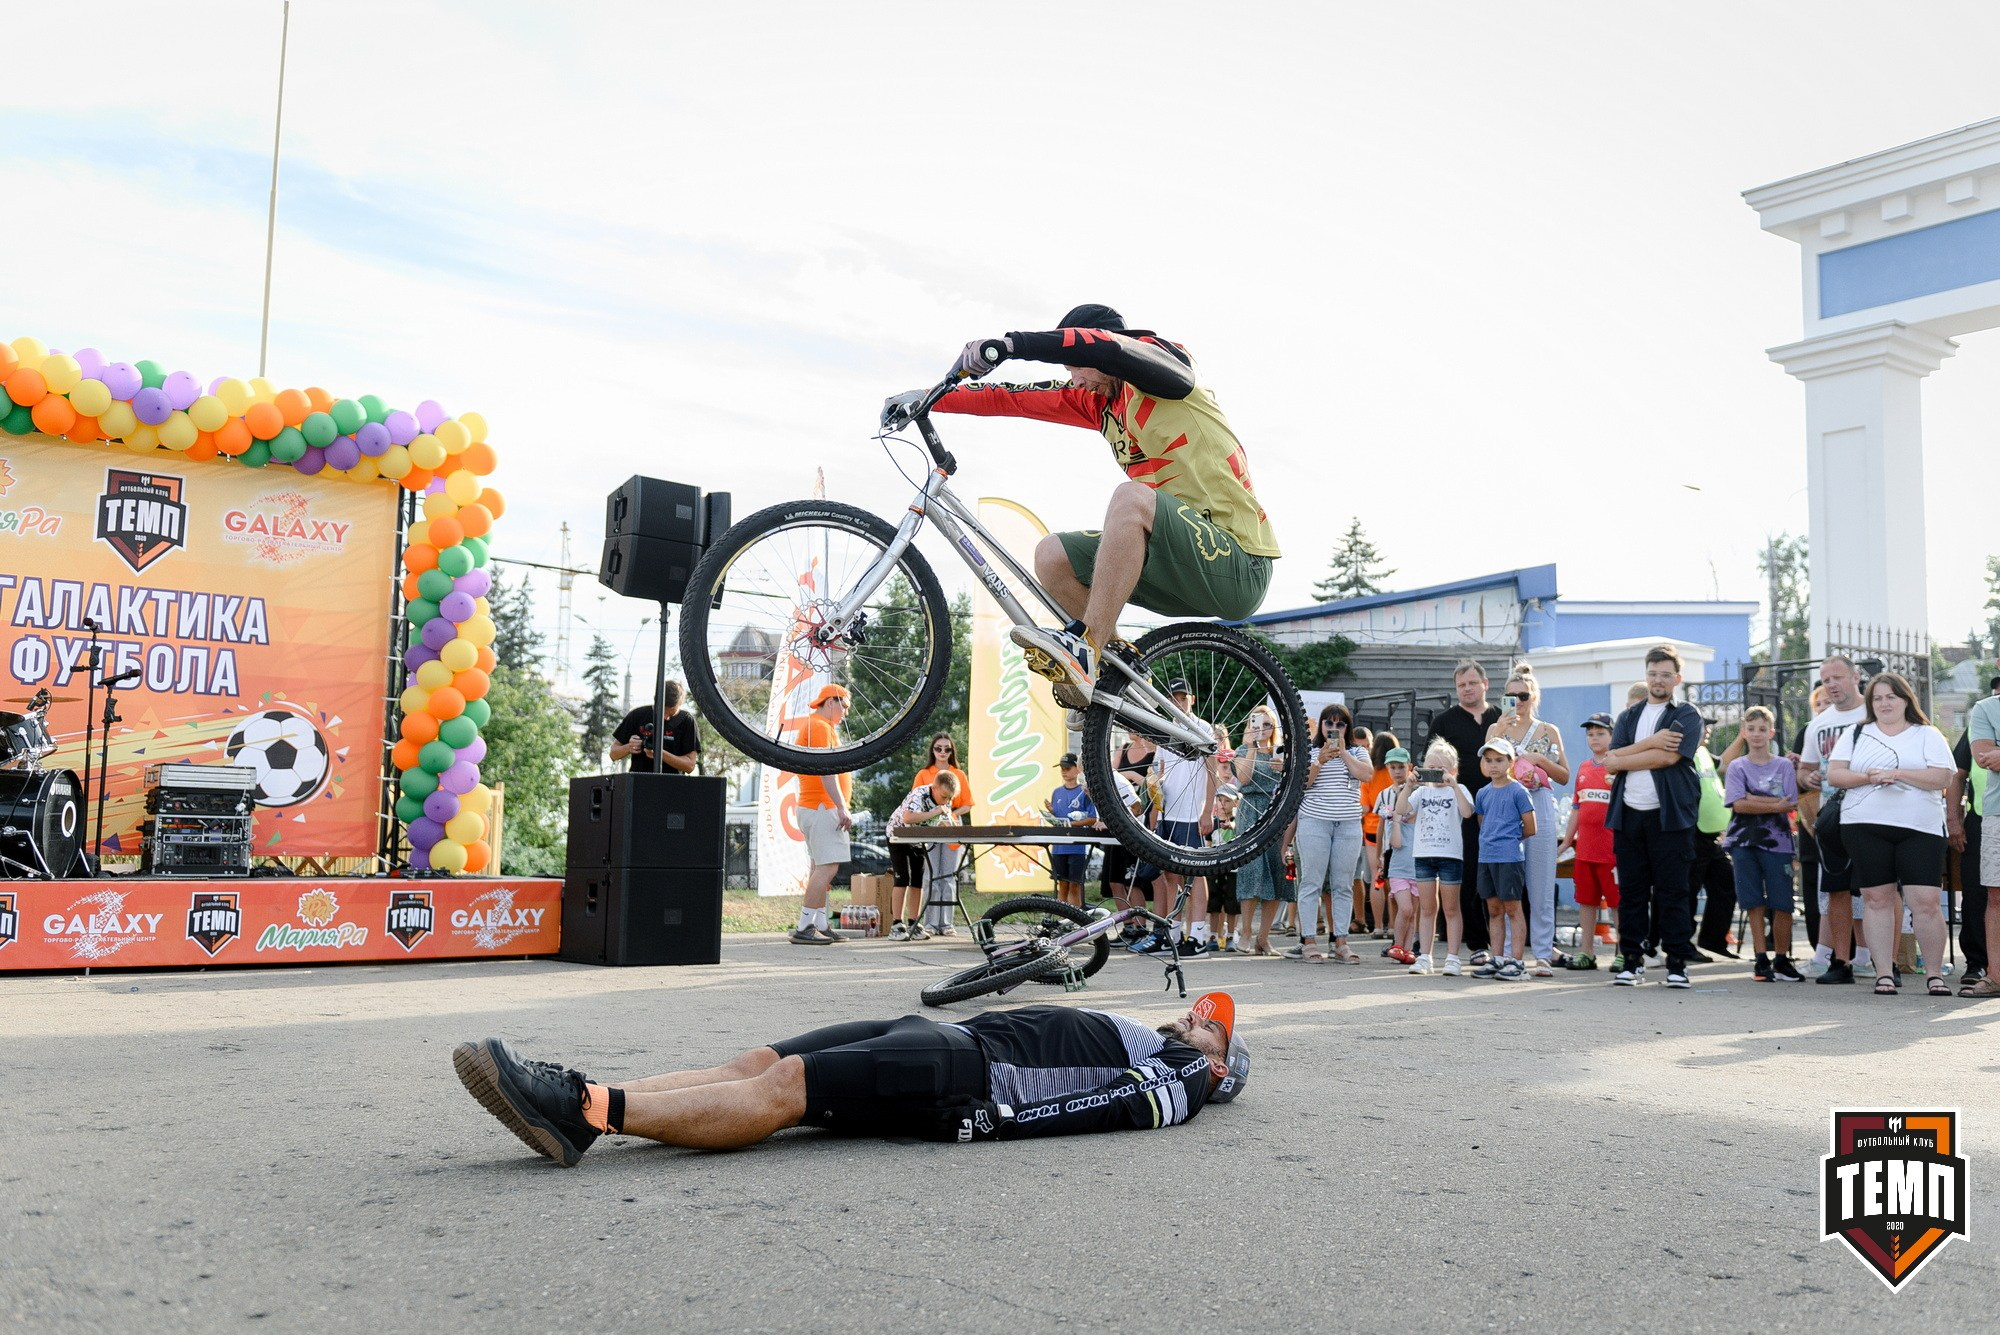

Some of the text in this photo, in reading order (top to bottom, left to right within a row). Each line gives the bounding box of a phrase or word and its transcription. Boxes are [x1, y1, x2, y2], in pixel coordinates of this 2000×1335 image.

[105, 499, 181, 540] ТЕМП
[794, 510, 831, 518] MICHELIN
[224, 511, 350, 543] GALAXY
[983, 563, 1010, 599] VANS
[1145, 634, 1180, 656] MICHELIN
[10, 634, 240, 697] ФУТБОЛА
[1180, 859, 1218, 867] MICHELIN
[43, 914, 164, 935] GALAXY
[193, 909, 237, 933] ТЕМП
[390, 907, 430, 930] ТЕМП
[450, 908, 545, 929] GALAXY
[1139, 1070, 1178, 1092] YOKO
[1016, 1103, 1060, 1123] YOKO
[1065, 1093, 1109, 1113] YOKO
